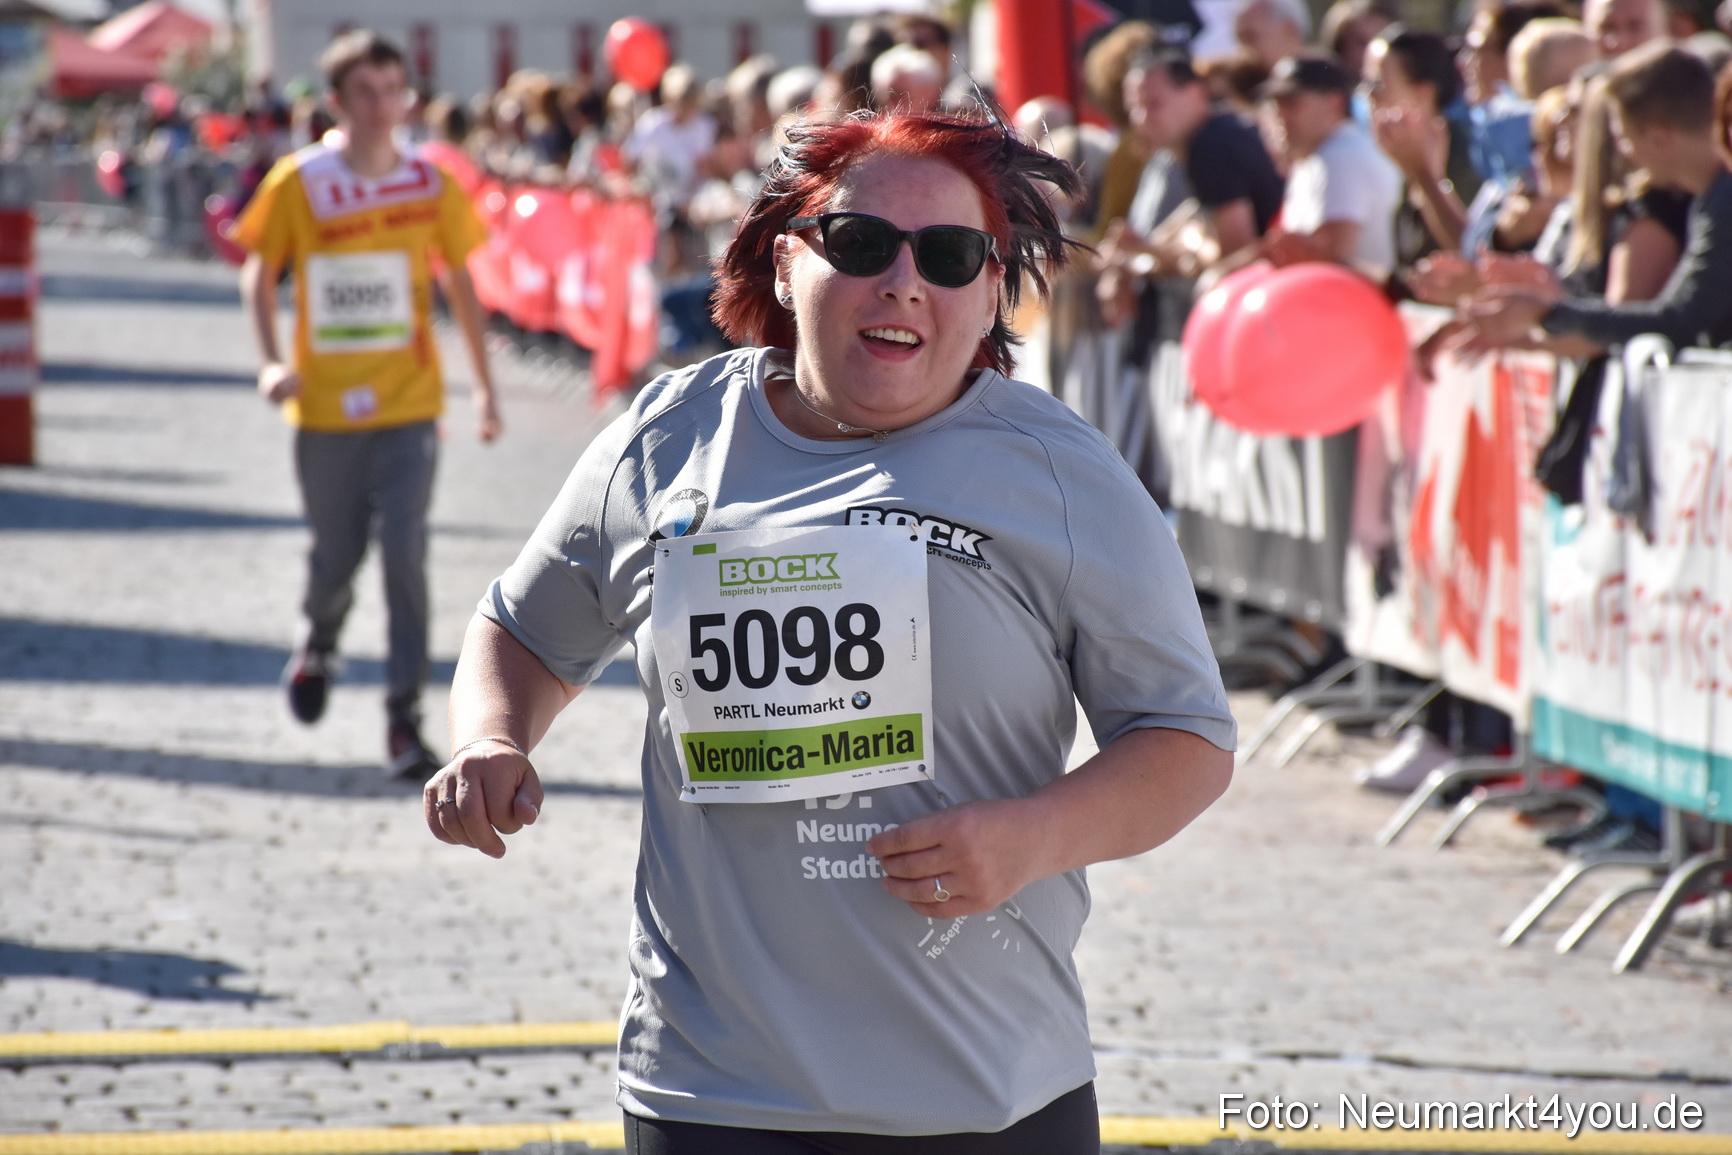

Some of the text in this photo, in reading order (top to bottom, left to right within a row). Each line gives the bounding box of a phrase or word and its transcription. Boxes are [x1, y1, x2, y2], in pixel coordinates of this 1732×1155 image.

[719, 553, 841, 586] BOCK
[945, 553, 992, 571] concepts
[719, 581, 843, 598] inspired by smart concepts
[689, 602, 885, 692] 5098
[674, 678, 684, 692] S
[714, 696, 846, 720] PARTL Neumarkt
[687, 724, 916, 774] Veronica-Maria
[801, 853, 889, 880] Stadt
[926, 944, 946, 960] 16.
